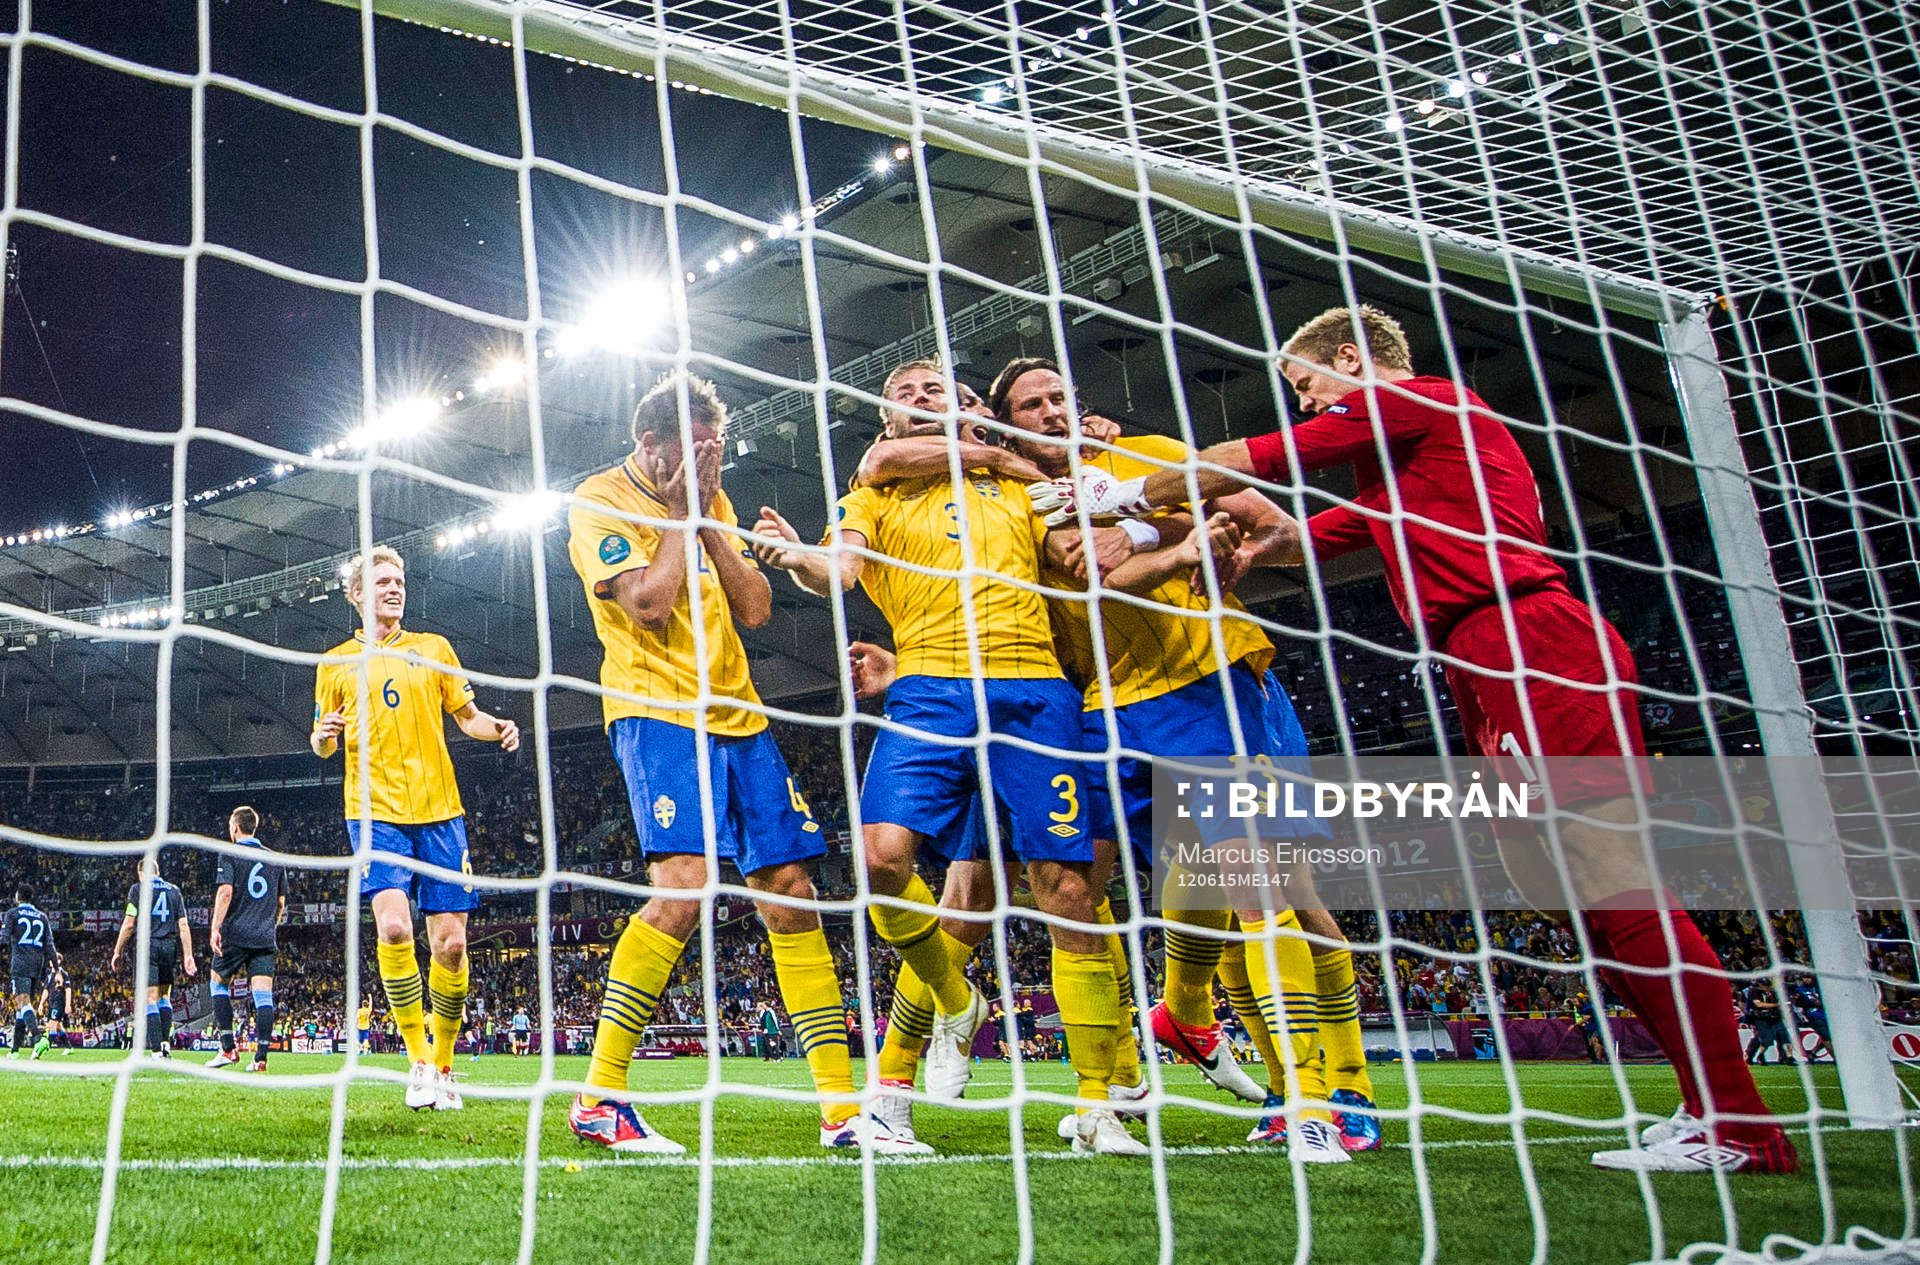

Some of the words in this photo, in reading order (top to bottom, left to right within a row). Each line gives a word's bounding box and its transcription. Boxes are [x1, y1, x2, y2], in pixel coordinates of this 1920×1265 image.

[383, 678, 400, 708] 6
[1500, 732, 1537, 782] 1
[786, 777, 813, 819] 4
[1048, 774, 1079, 823] 3
[248, 862, 268, 899] 6
[152, 891, 170, 923] 4
[17, 917, 45, 948] 22
